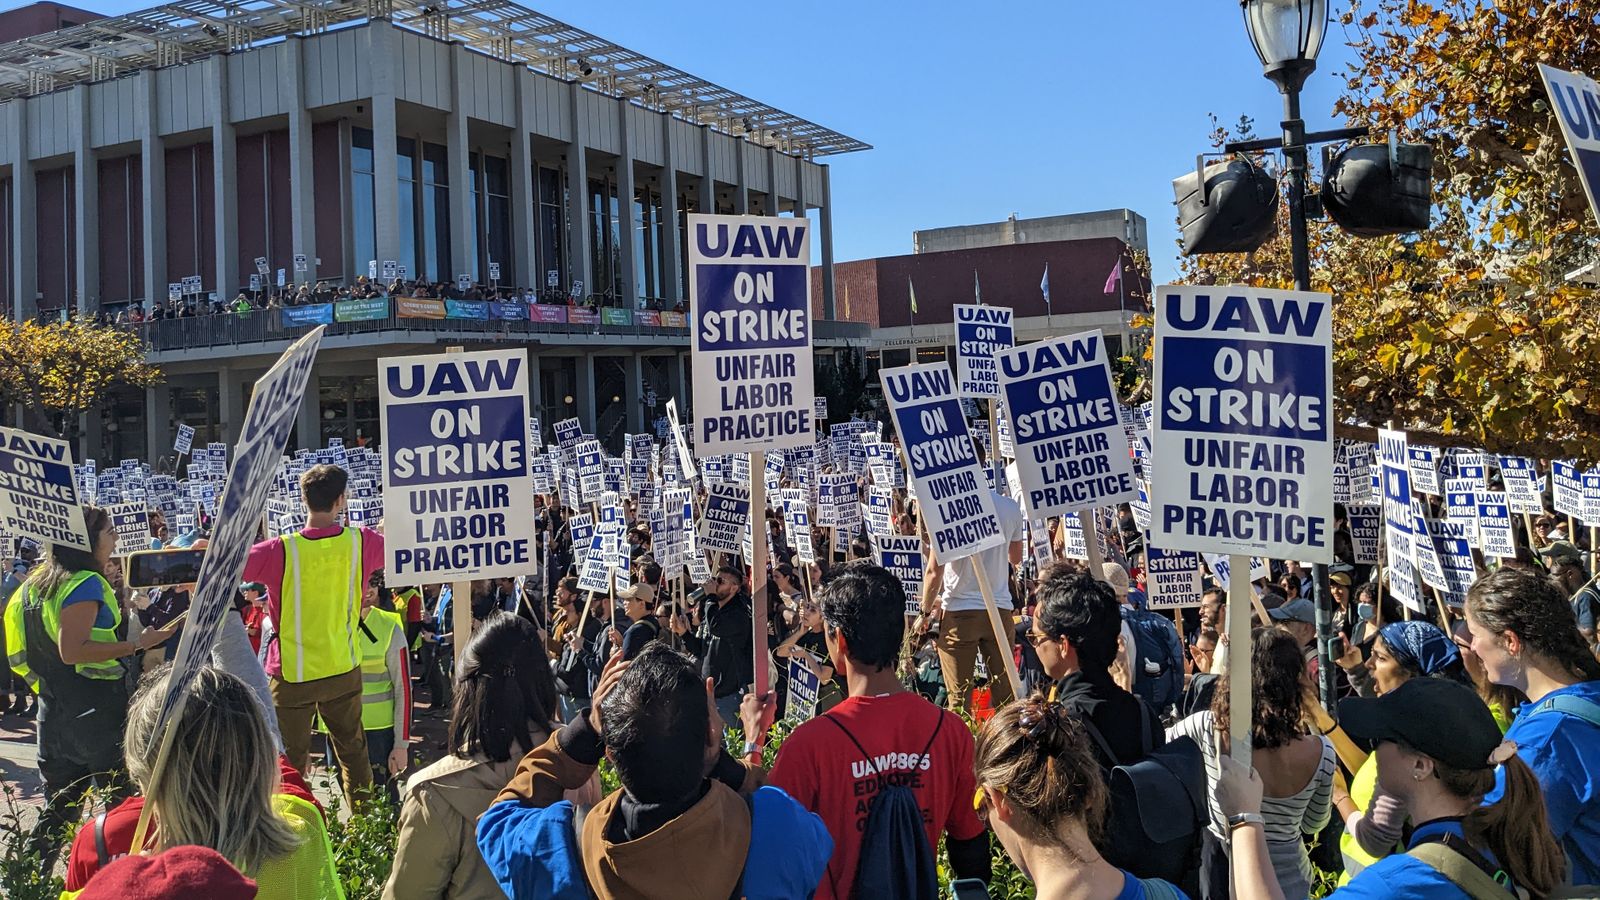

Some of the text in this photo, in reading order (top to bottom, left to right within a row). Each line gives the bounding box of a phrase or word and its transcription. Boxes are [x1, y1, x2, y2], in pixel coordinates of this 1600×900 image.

[696, 223, 806, 259] UAW
[733, 270, 775, 304] ON
[958, 307, 1011, 325] UAW
[1165, 294, 1324, 338] UAW
[702, 308, 805, 343] STRIKE
[975, 326, 996, 341] ON
[1001, 335, 1099, 379] UAW
[715, 352, 796, 382] UNFAIR
[968, 358, 997, 370] UNFA
[1213, 346, 1274, 384] ON
[386, 357, 522, 399] UAW
[970, 370, 998, 382] LABO
[886, 367, 952, 403] UAW
[962, 381, 1001, 394] PRACT
[1038, 374, 1078, 401] ON
[720, 382, 793, 411] LABOR
[1166, 386, 1321, 432] STRIKE
[430, 405, 481, 439] ON
[920, 406, 949, 437] ON
[1016, 397, 1114, 438] STRIKE
[555, 420, 579, 432] UAW
[703, 408, 811, 443] PRACTICE
[564, 430, 574, 438] ON
[316, 449, 334, 457] UAW
[346, 448, 364, 457] UAW
[577, 442, 598, 454] UAW
[794, 444, 813, 452] UAW
[910, 433, 975, 472] STRIKE
[1032, 431, 1110, 464] UNFAIR
[1347, 444, 1368, 456] UAW
[1380, 436, 1405, 465] UAW
[393, 439, 523, 479] STRIKE
[584, 455, 593, 465] ON
[1184, 437, 1305, 475] UNFAIR
[1414, 451, 1425, 460] ON
[1458, 456, 1480, 465] UAW
[13, 456, 46, 479] ON
[1040, 453, 1111, 485] LABOR
[1354, 458, 1364, 467] ON
[1411, 460, 1434, 469] STRIKE
[1507, 459, 1519, 468] ON
[580, 464, 601, 475] STRIKE
[1350, 466, 1369, 477] STRIKE
[1466, 468, 1476, 476] ON
[1503, 469, 1528, 477] STRIKE
[1561, 466, 1573, 478] ON
[833, 473, 856, 485] UAW
[927, 470, 978, 501] UNFAIR
[1388, 471, 1400, 497] ON
[1554, 474, 1582, 492] STRIKE
[1587, 477, 1599, 487] ON
[0, 472, 74, 502] STRIKE
[712, 483, 750, 500] UAW
[841, 484, 850, 493] ON
[1030, 472, 1133, 510] PRACTICE
[1189, 472, 1299, 509] LABOR
[1414, 482, 1437, 492] PRACTICE
[1447, 481, 1474, 492] UAW
[409, 483, 510, 515] UNFAIR
[782, 490, 800, 500] UAW
[834, 493, 858, 505] STRIKE
[1455, 494, 1467, 505] ON
[1476, 493, 1505, 503] UAW
[1509, 493, 1535, 502] PRACTICE
[1558, 487, 1580, 500] UNFAIR
[8, 492, 70, 518] UNFAIR
[720, 499, 737, 511] ON
[838, 504, 857, 512] UNFAIR
[875, 497, 885, 506] ON
[1560, 495, 1579, 508] LABOR
[112, 503, 145, 515] UAW
[840, 510, 857, 519] LABOR
[937, 492, 984, 525] LABOR
[1386, 497, 1412, 529] STRIKE
[1449, 506, 1475, 516] STRIKE
[1486, 506, 1498, 516] ON
[1556, 501, 1583, 517] PRACTICE
[15, 506, 70, 531] LABOR
[123, 515, 137, 524] ON
[570, 515, 591, 528] UAW
[707, 508, 746, 524] STRIKE
[836, 516, 860, 526] PRACTICE
[1480, 517, 1509, 527] STRIKE
[116, 521, 148, 534] STRIKE
[415, 512, 506, 544] LABOR
[709, 521, 739, 534] UNFAIR
[1163, 504, 1325, 548] PRACTICE
[1362, 519, 1378, 527] ON
[1428, 521, 1464, 536] UAW
[6, 516, 87, 547] PRACTICE
[120, 531, 146, 541] UNFAIR
[578, 528, 587, 537] ON
[708, 530, 736, 542] LABOR
[934, 514, 1000, 554] PRACTICE
[1353, 528, 1377, 537] STRI
[1484, 529, 1507, 538] UNFAIR
[122, 539, 145, 547] LABOR
[700, 537, 740, 551] PRACTICE
[880, 538, 921, 551] UAW
[1444, 540, 1458, 553] ON
[1487, 538, 1507, 546] LABOR
[1484, 544, 1514, 554] PRACTICE
[394, 538, 529, 575] PRACTICE
[893, 554, 910, 566] ON
[1440, 554, 1474, 570] STRIKE
[1149, 556, 1197, 572] STRIKE
[1393, 552, 1412, 578] LABOR
[586, 569, 607, 579] LABOR
[1156, 572, 1193, 583] UNFAIR
[579, 577, 609, 590] PRACTICE
[1159, 584, 1192, 594] LABOR
[1152, 593, 1200, 605] PRACTICE
[797, 668, 809, 685] ON
[790, 678, 816, 702] STRIKE
